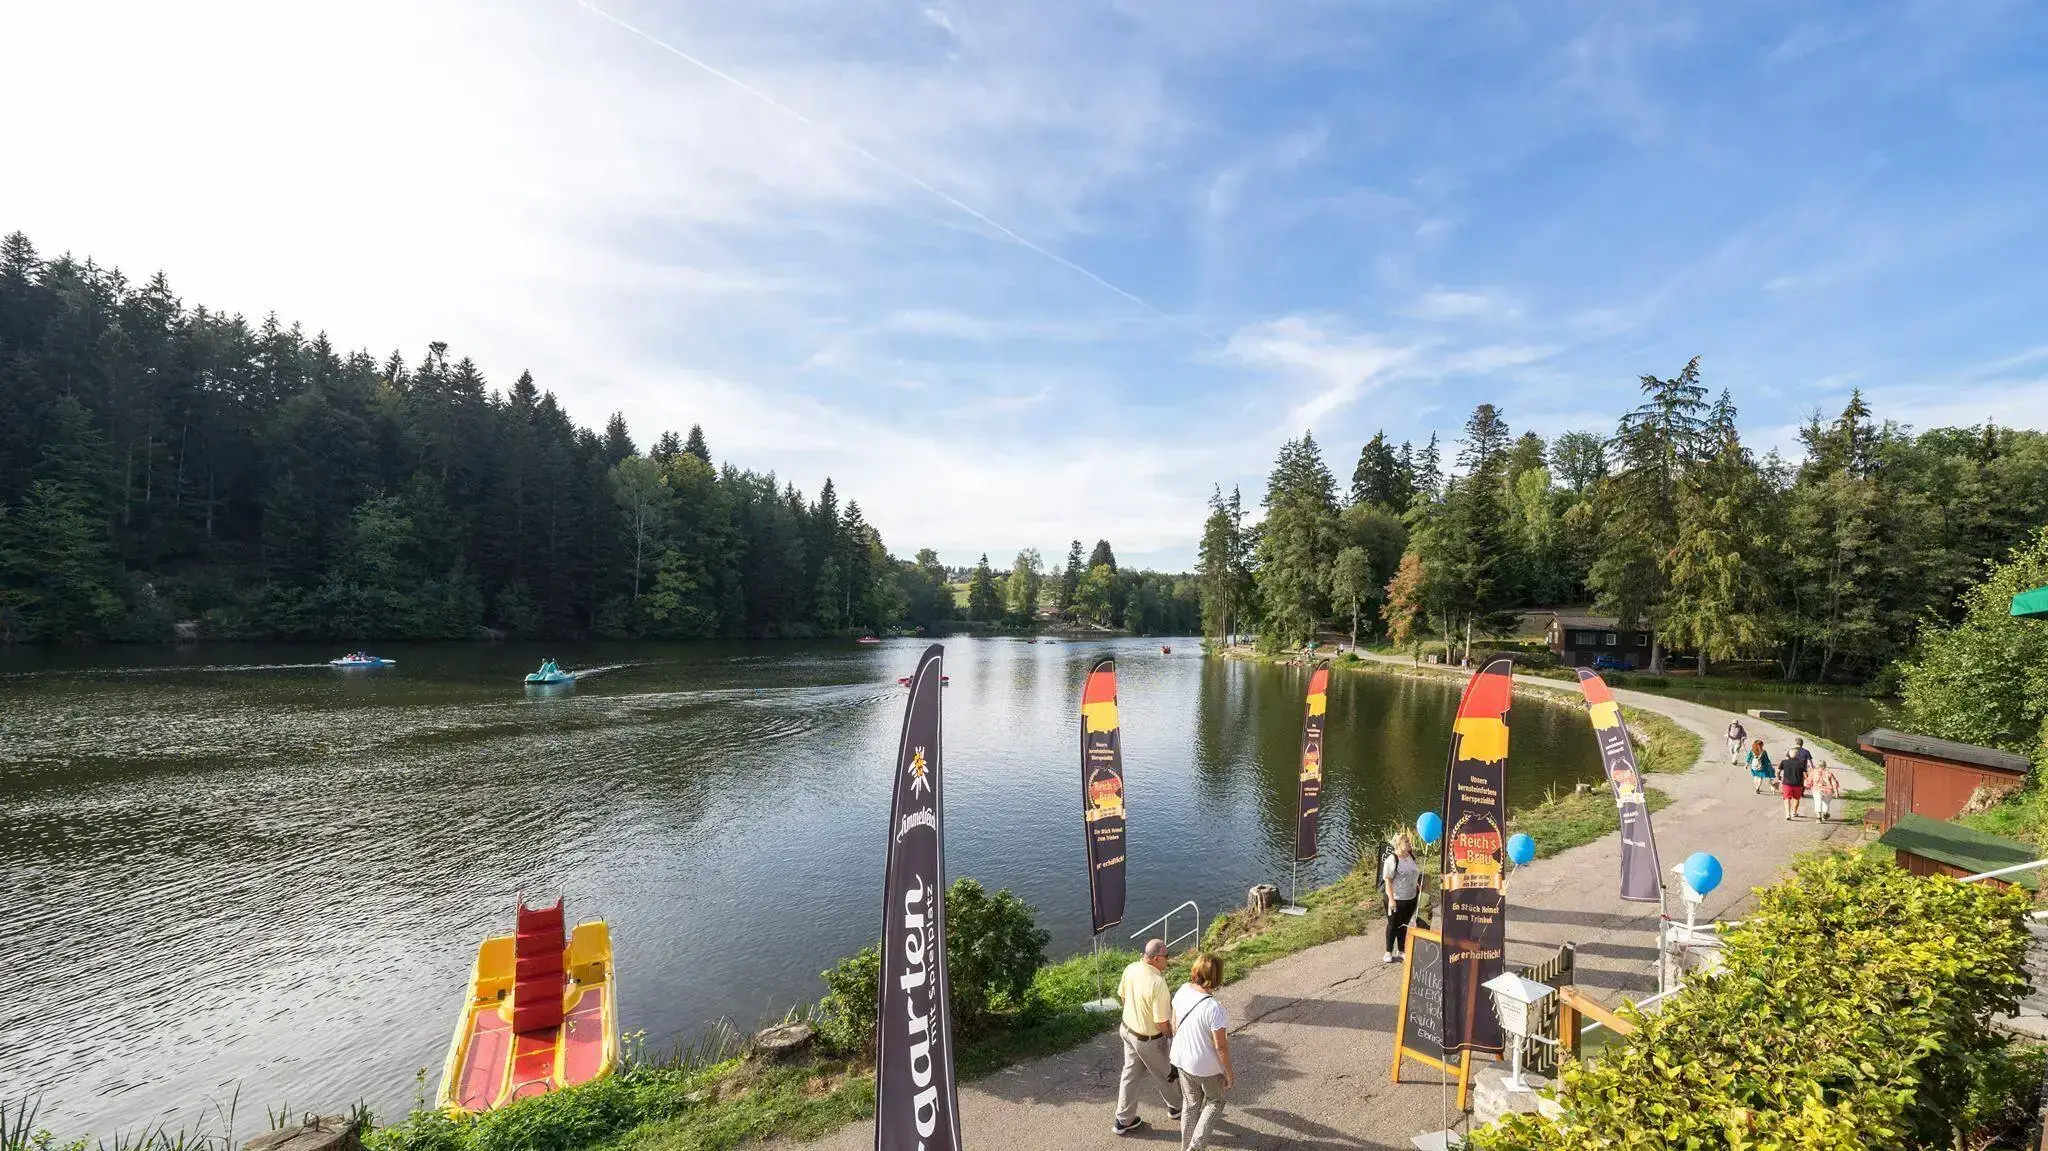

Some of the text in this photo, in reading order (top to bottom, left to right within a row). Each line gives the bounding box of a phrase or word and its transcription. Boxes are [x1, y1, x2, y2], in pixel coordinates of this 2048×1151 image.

[1467, 850, 1491, 865] Bräu
[1461, 903, 1481, 913] Stück
[1461, 949, 1501, 960] erhältlich!
[929, 1003, 937, 1046] mit
